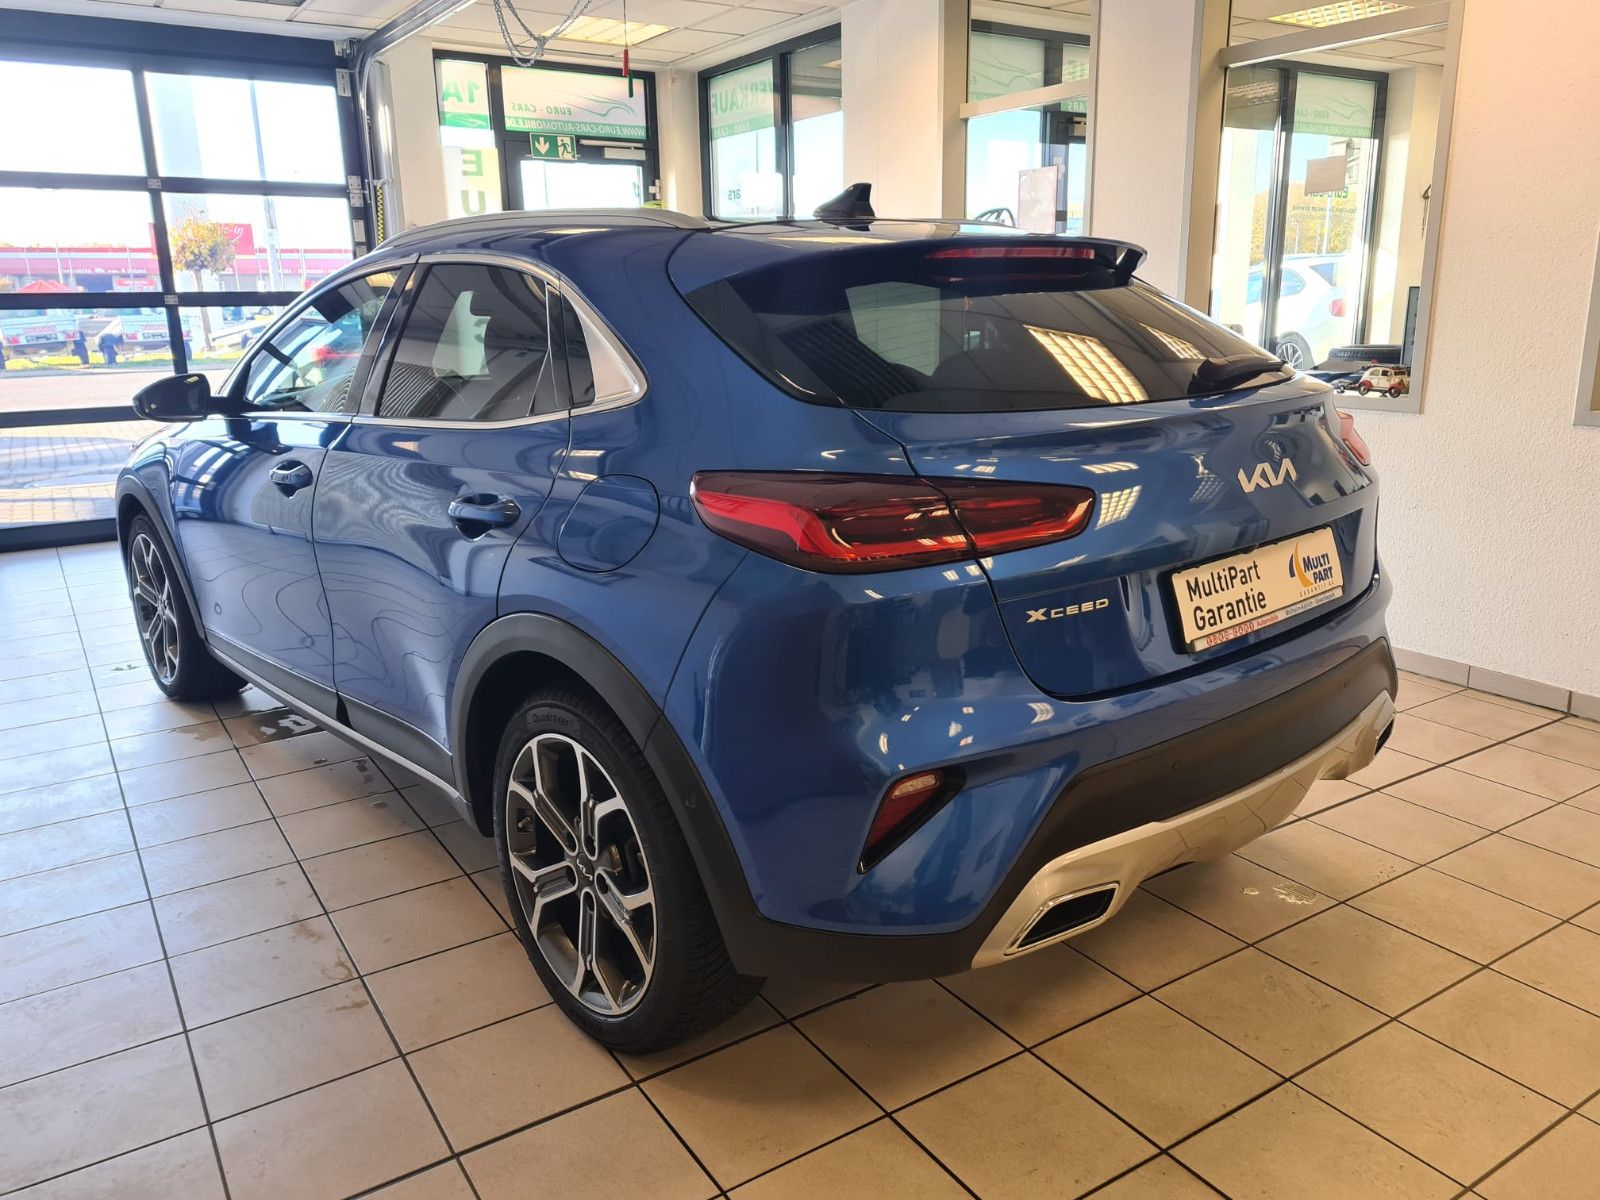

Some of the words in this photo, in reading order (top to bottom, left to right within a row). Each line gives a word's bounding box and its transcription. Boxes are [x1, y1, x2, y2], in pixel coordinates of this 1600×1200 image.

[1237, 457, 1298, 493] KIA
[1186, 560, 1261, 602] MultiPart
[1302, 552, 1331, 576] MULTI
[1312, 566, 1333, 584] PART
[1193, 588, 1267, 632] Garantie
